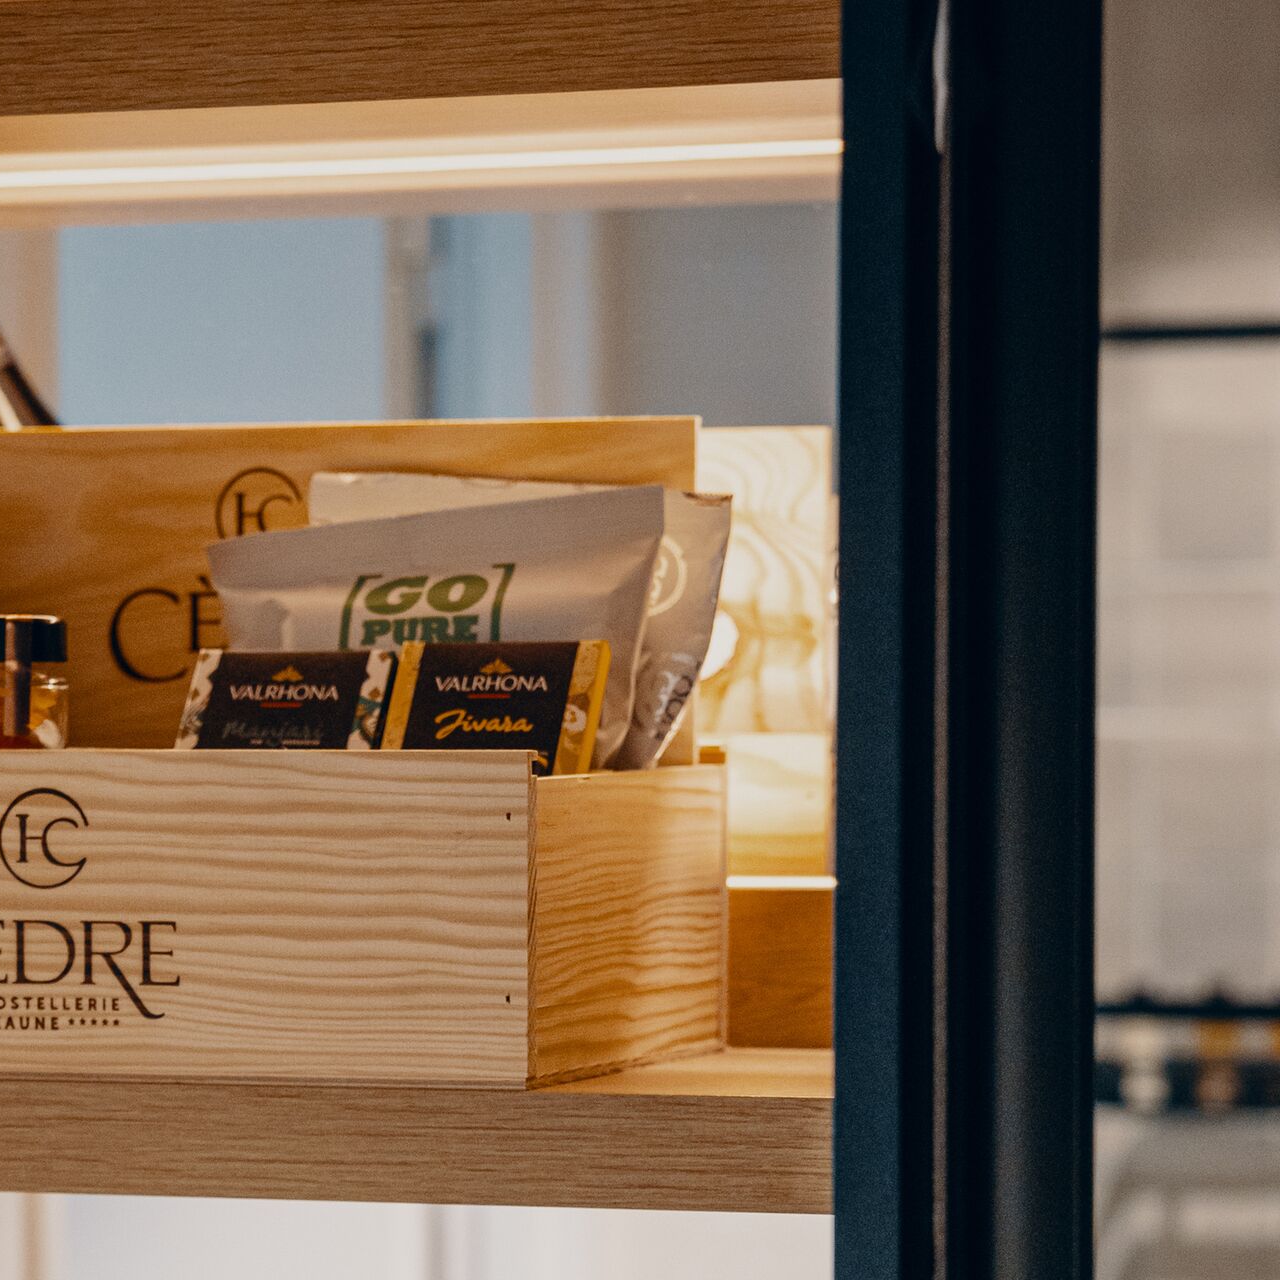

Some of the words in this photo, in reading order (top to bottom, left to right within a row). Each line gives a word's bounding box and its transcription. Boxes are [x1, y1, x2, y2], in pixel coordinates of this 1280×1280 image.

[363, 574, 489, 615] GO
[360, 615, 480, 645] PURE
[229, 684, 339, 701] VALRHONA
[435, 675, 548, 693] VALRHONA
[434, 707, 535, 740] Jivara
